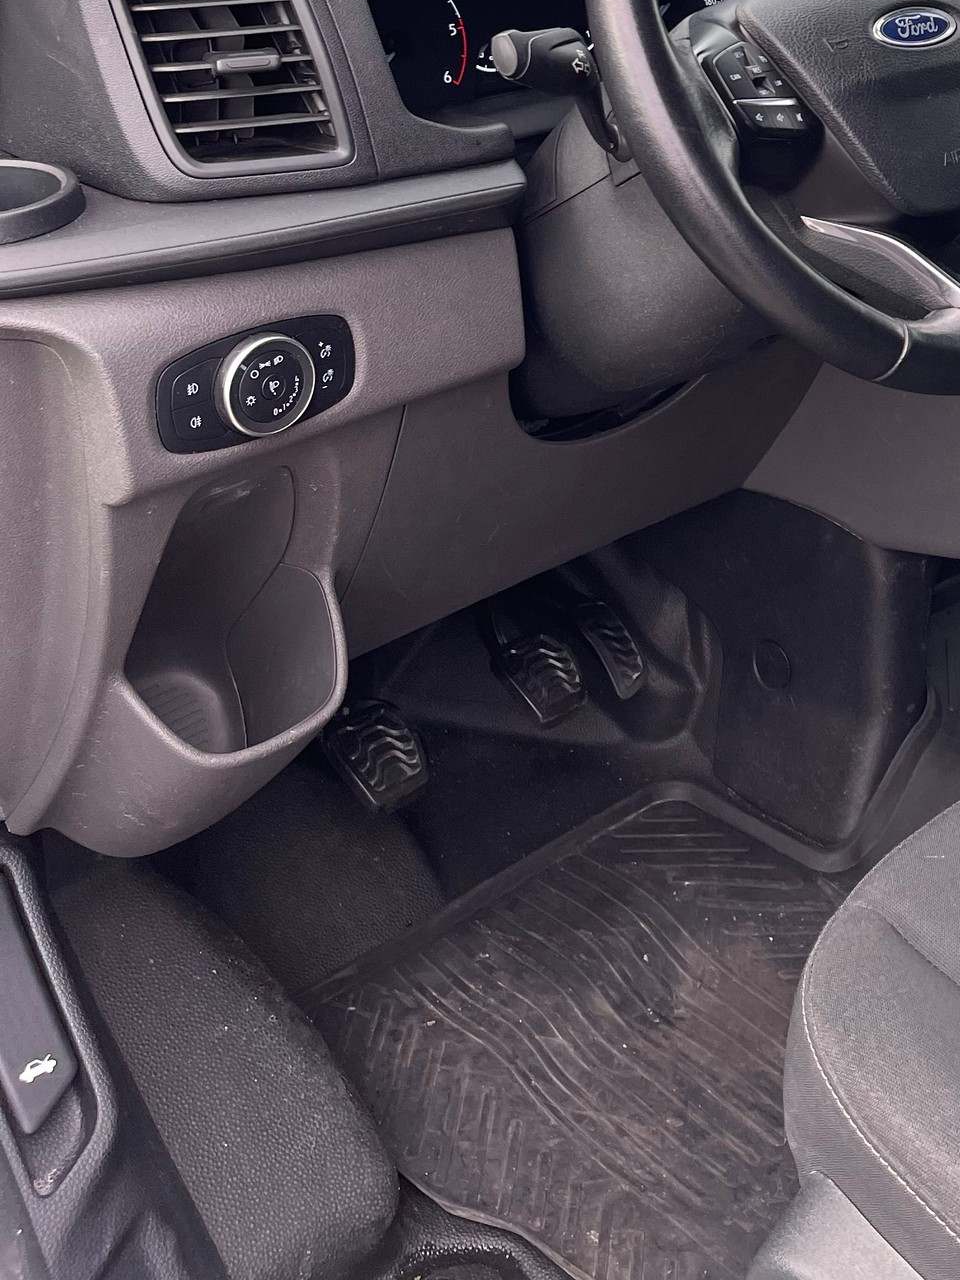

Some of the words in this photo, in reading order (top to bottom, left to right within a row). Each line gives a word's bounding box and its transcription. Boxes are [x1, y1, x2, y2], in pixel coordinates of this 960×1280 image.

[448, 23, 457, 36] 5
[895, 13, 938, 39] Ford
[443, 70, 452, 83] 6
